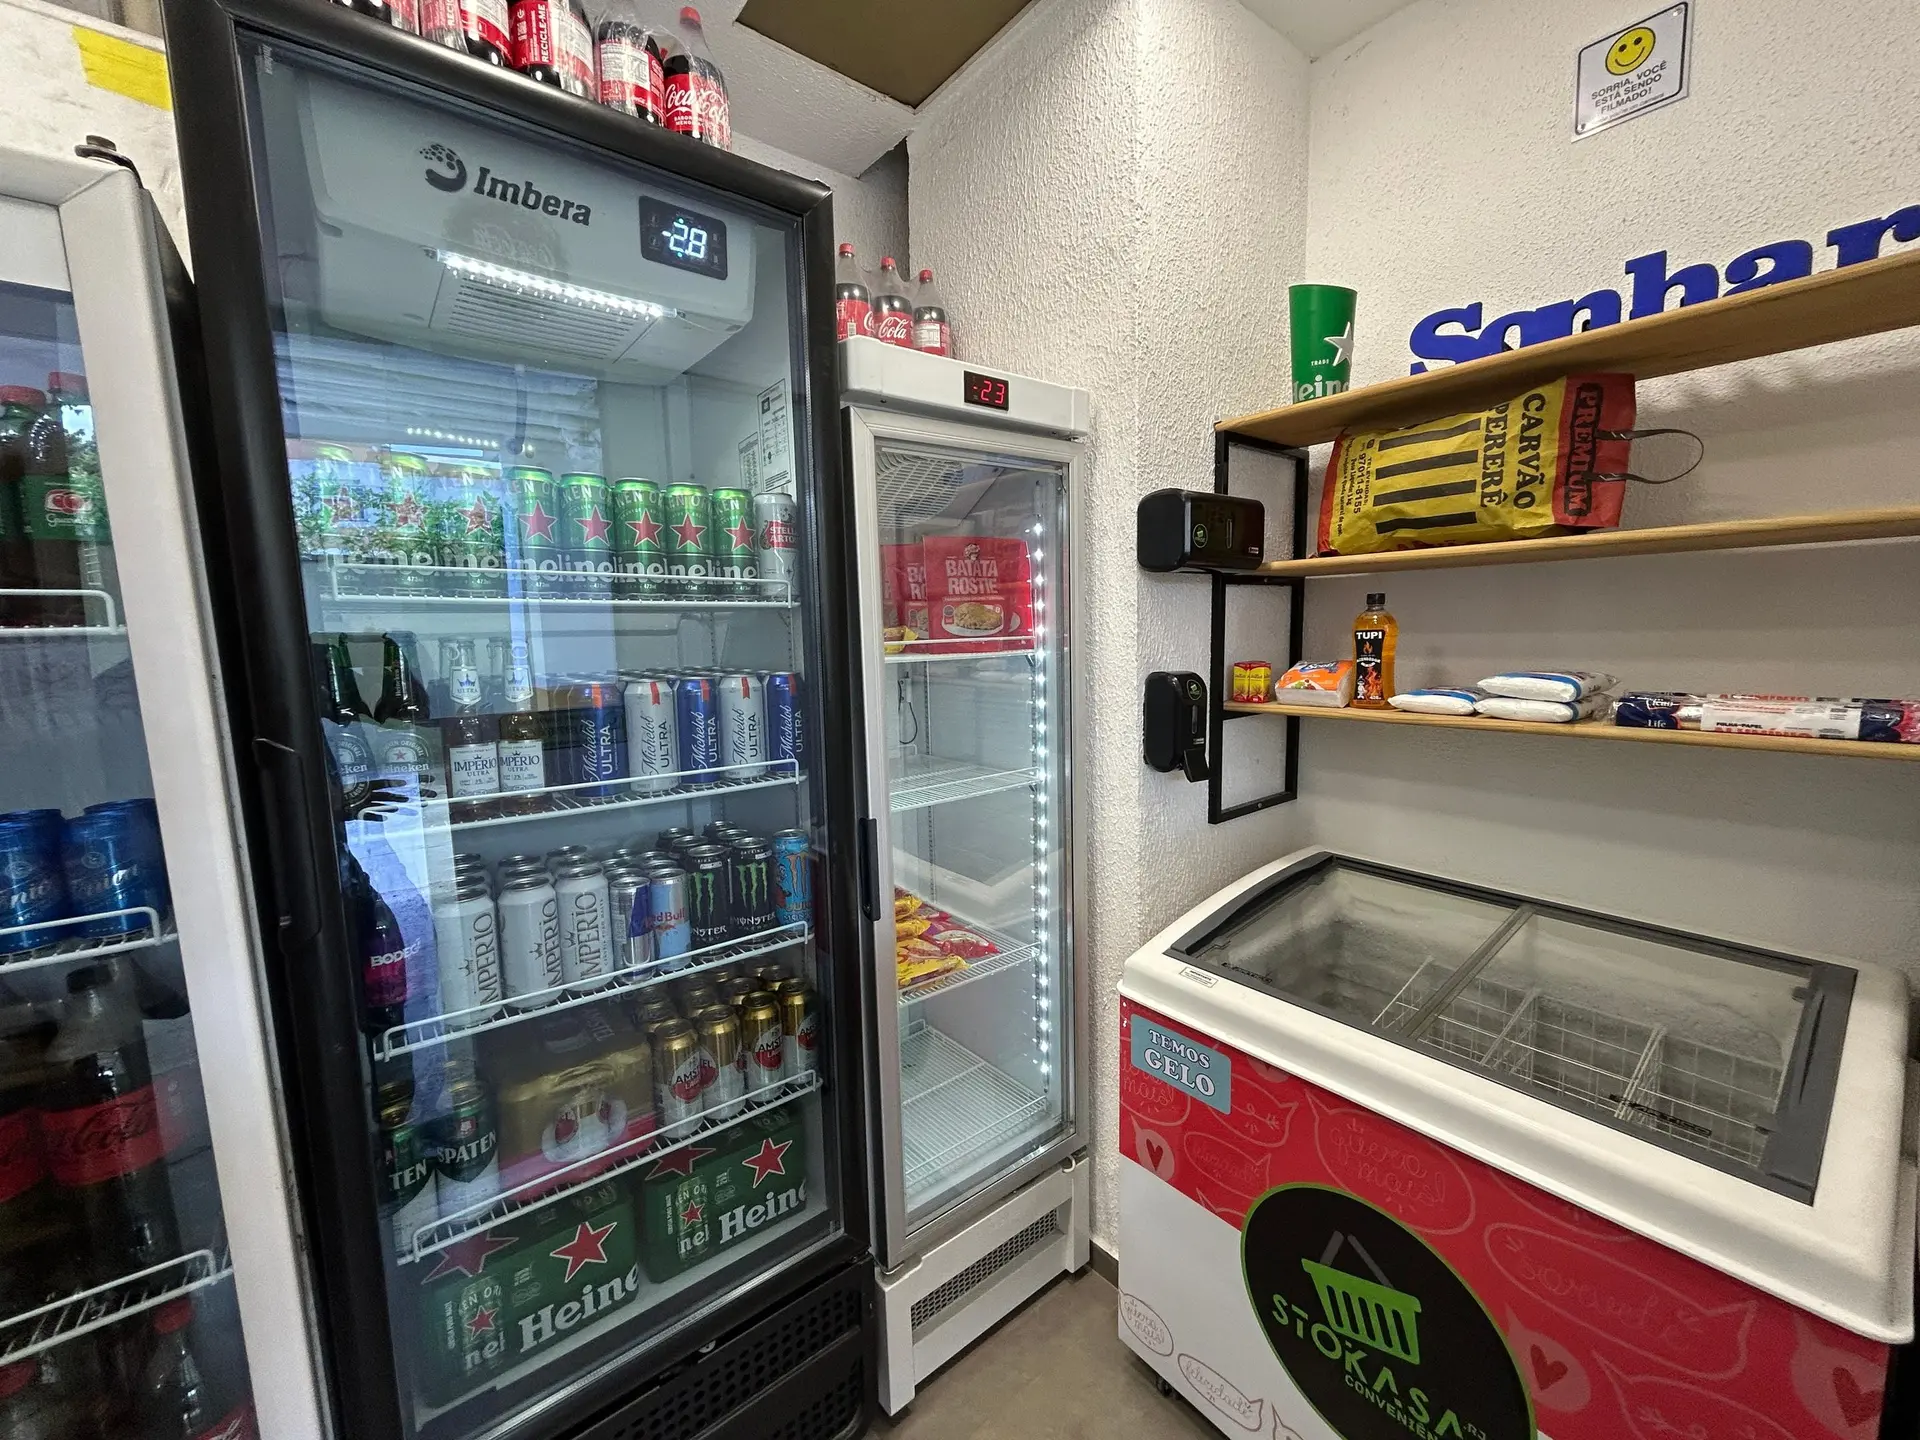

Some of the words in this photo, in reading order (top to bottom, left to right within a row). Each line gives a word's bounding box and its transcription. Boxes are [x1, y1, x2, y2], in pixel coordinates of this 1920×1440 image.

[538, 4, 549, 63] RECICLE-ME
[1601, 87, 1652, 114] FILMADO!
[1624, 73, 1662, 96] SENDO
[473, 166, 592, 226] Imbera
[972, 380, 1005, 404] -23
[1480, 402, 1510, 508] PERERÊ
[1513, 393, 1546, 509] CARVÃO
[1353, 452, 1367, 514] 97011-8155
[945, 559, 999, 577] BATATA
[947, 577, 999, 595] ROSTIE
[1356, 631, 1383, 640] TUPI
[640, 715, 659, 776] Michelob
[659, 718, 670, 768] ULTRA
[690, 711, 708, 769] Michelob
[707, 717, 718, 763] ULTRA
[732, 707, 748, 765] Michelob
[748, 712, 758, 758] ULTRA
[1647, 719, 1667, 728] Life
[454, 757, 497, 773] IMPERIO
[500, 755, 540, 767] MPERIO
[581, 719, 600, 782] Michelob
[600, 724, 613, 775] ULTRA
[664, 907, 685, 922] Bull
[1149, 1028, 1211, 1069] TEMOS
[1144, 1047, 1216, 1097] GELO
[437, 1129, 497, 1164] SPATEN
